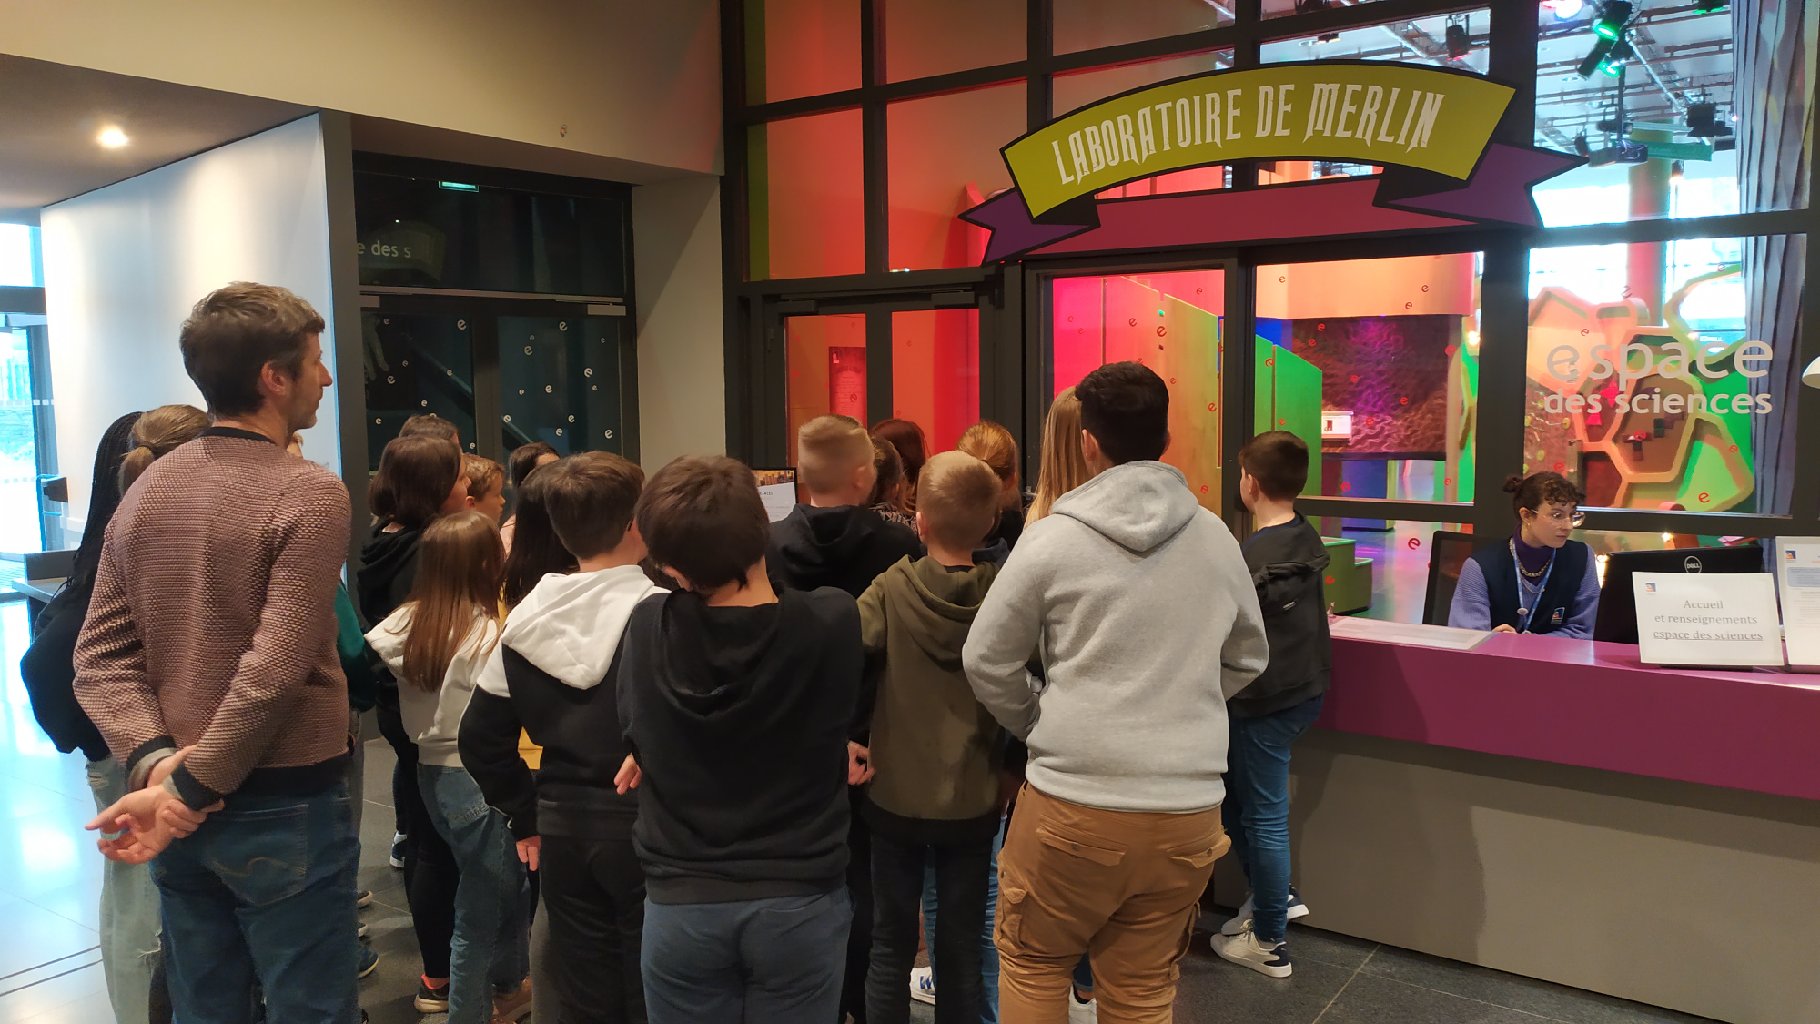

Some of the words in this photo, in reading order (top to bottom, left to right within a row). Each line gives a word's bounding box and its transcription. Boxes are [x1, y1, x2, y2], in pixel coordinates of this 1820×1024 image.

[1051, 89, 1241, 185] LABORATOIRE
[1255, 84, 1295, 138] DE
[1302, 82, 1446, 153] MERLIN
[371, 240, 399, 258] des
[1547, 340, 1774, 391] espace
[1543, 388, 1602, 415] des
[1615, 388, 1773, 415] sciences
[1683, 600, 1724, 609] Accueil
[1654, 615, 1665, 623] et
[1668, 614, 1758, 625] renseignements
[1653, 631, 1690, 641] espace
[1693, 630, 1713, 640] des
[1715, 631, 1764, 641] sciences
